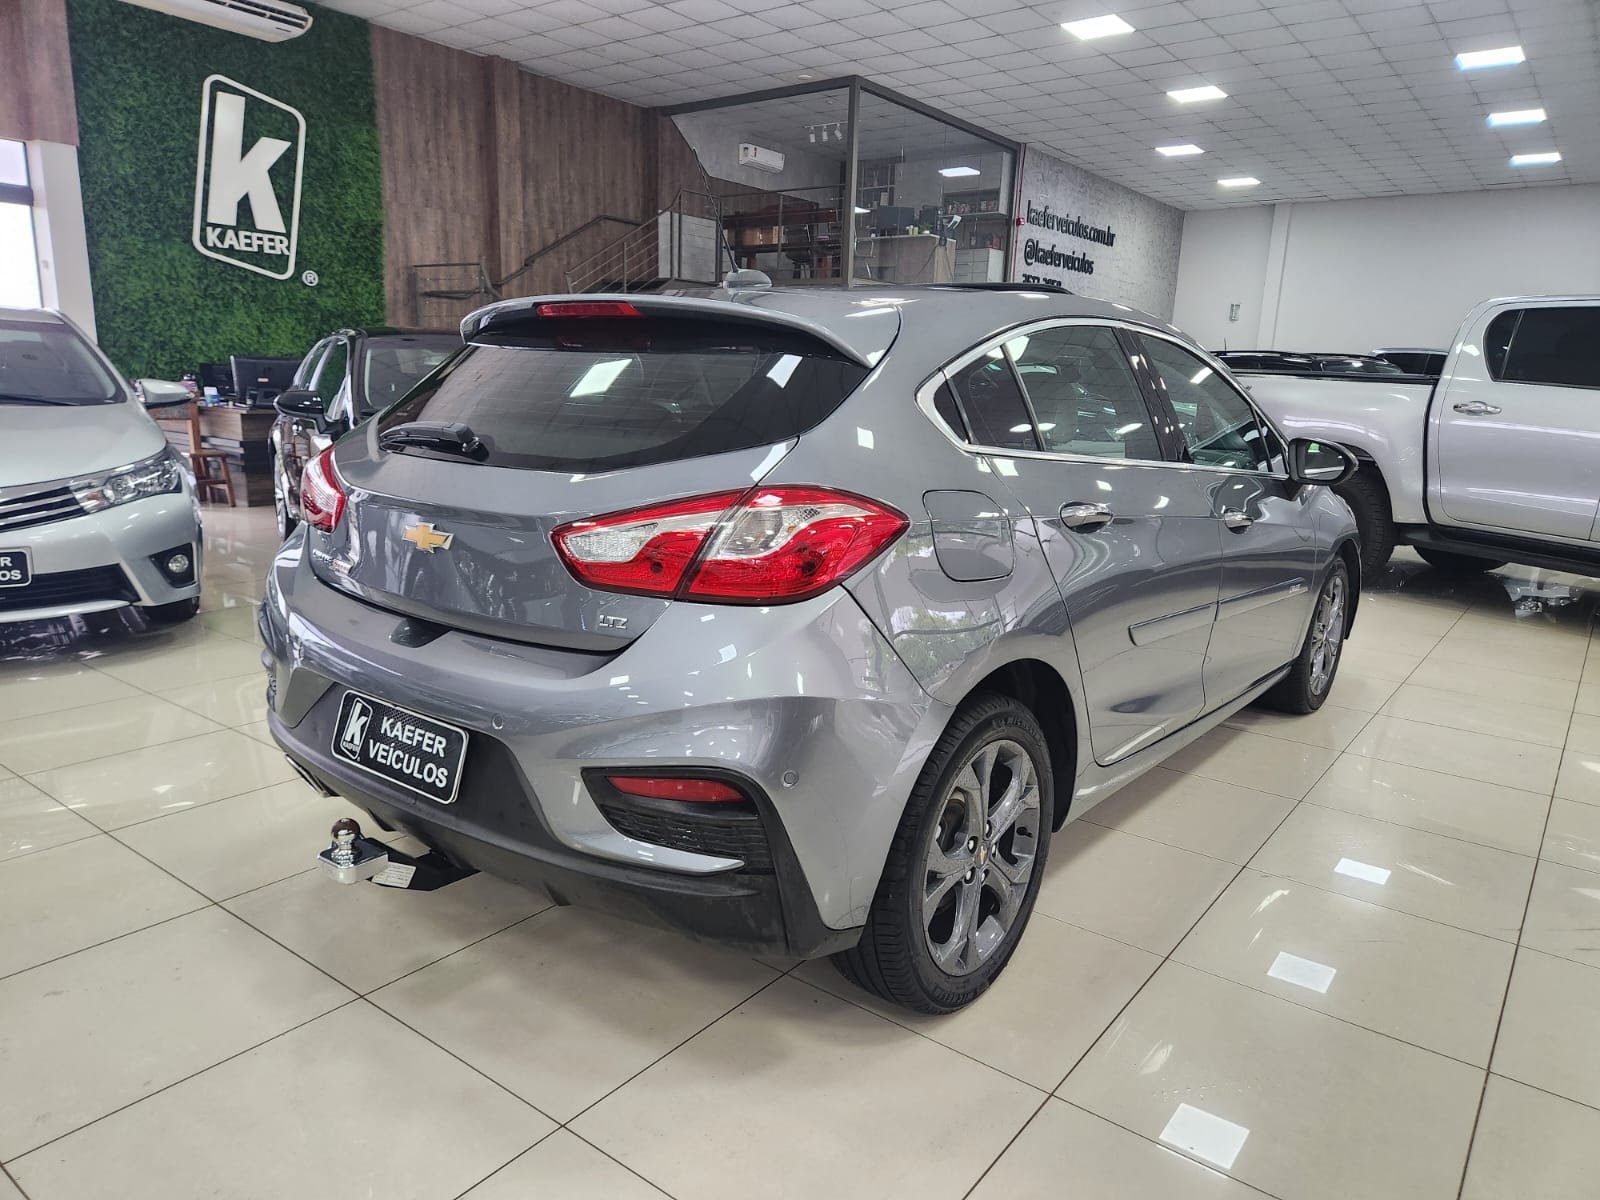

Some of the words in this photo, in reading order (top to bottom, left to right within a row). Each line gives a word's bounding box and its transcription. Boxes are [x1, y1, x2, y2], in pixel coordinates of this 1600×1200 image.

[205, 226, 290, 255] KAEFER
[1026, 200, 1116, 247] kaeferveiculos.com.br
[1023, 238, 1094, 275] @kaeferveiculos
[599, 614, 628, 629] LTZ
[380, 716, 447, 758] KAEFER
[369, 739, 449, 788] VEÍCULOS
